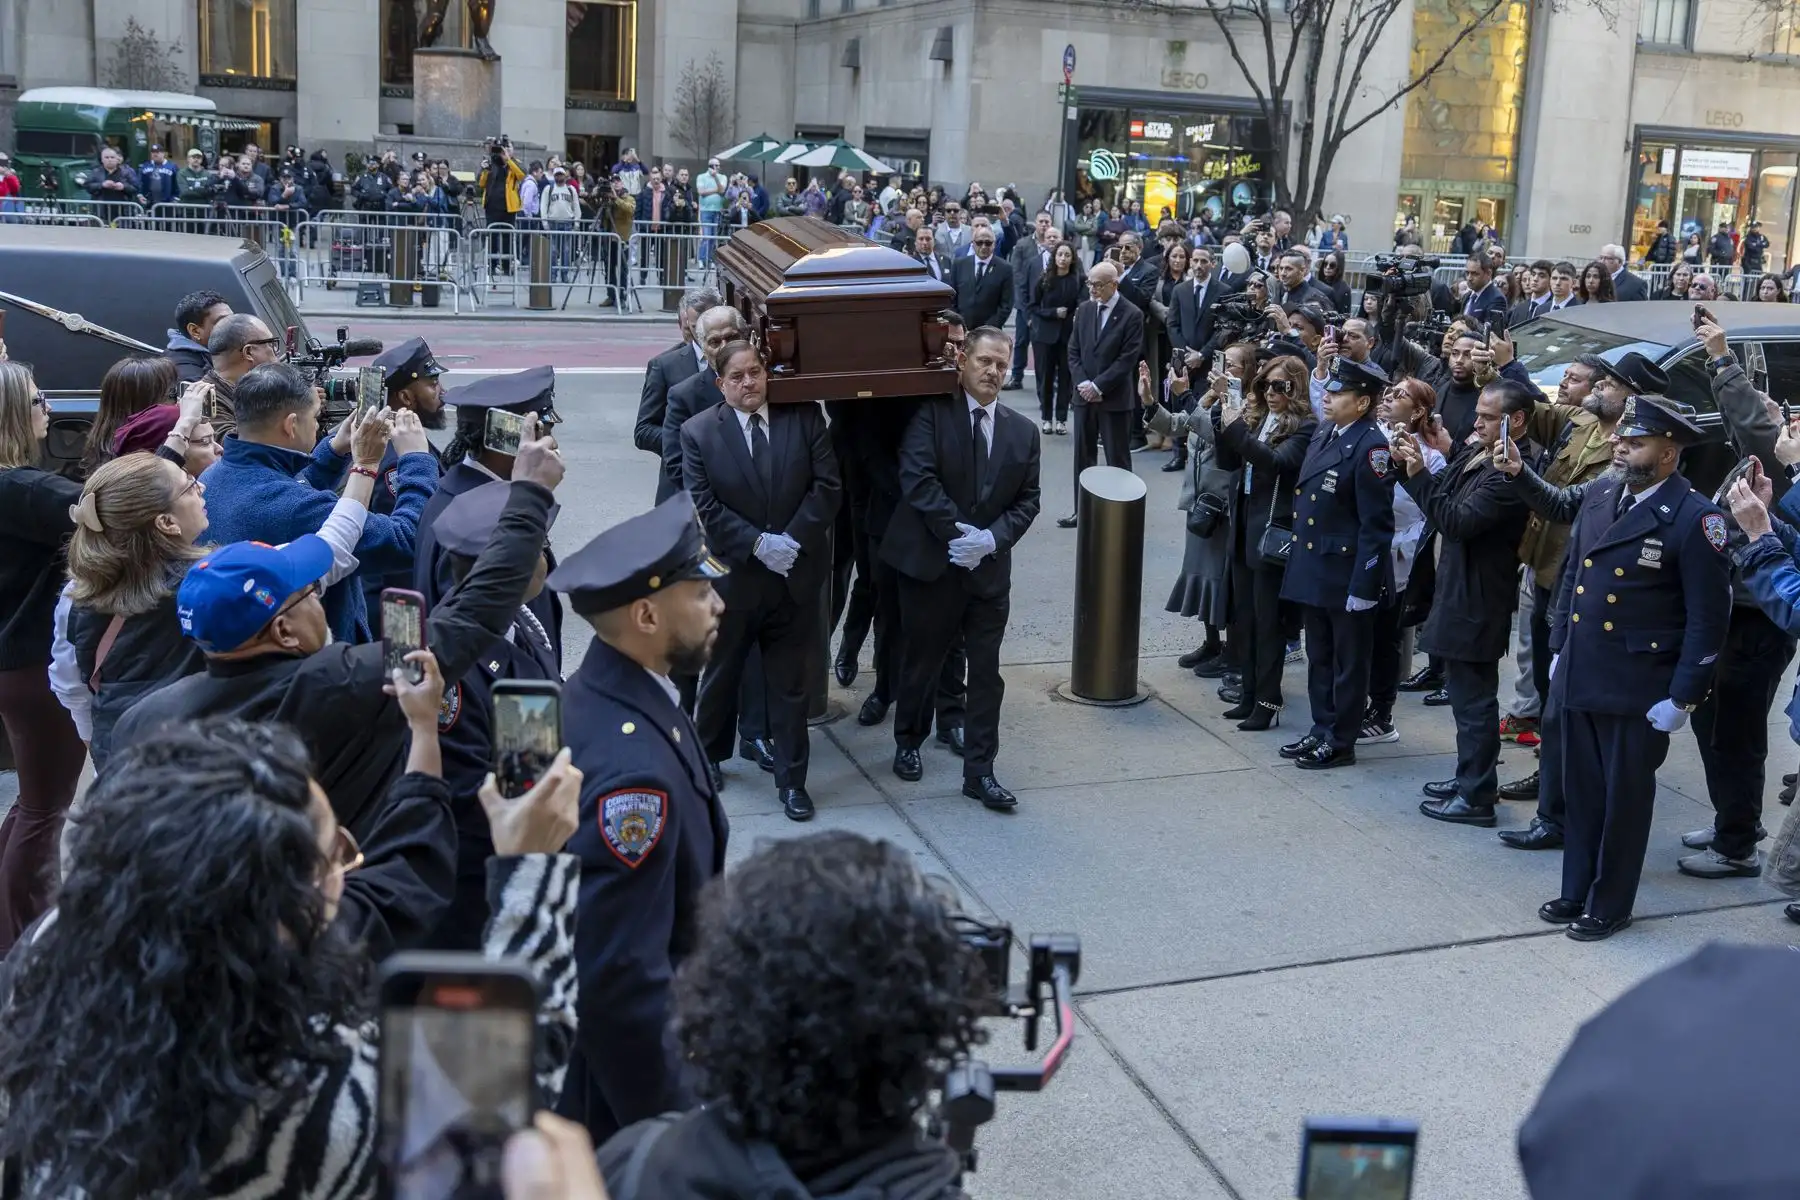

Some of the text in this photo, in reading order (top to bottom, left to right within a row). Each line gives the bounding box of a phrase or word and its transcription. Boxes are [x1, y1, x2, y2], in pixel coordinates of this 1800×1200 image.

[1161, 68, 1208, 89] LEGO
[1705, 109, 1744, 127] LEGO
[1569, 224, 1592, 234] LEGO
[605, 793, 661, 809] CORRECTION
[605, 801, 661, 819] DEPARTMENT
